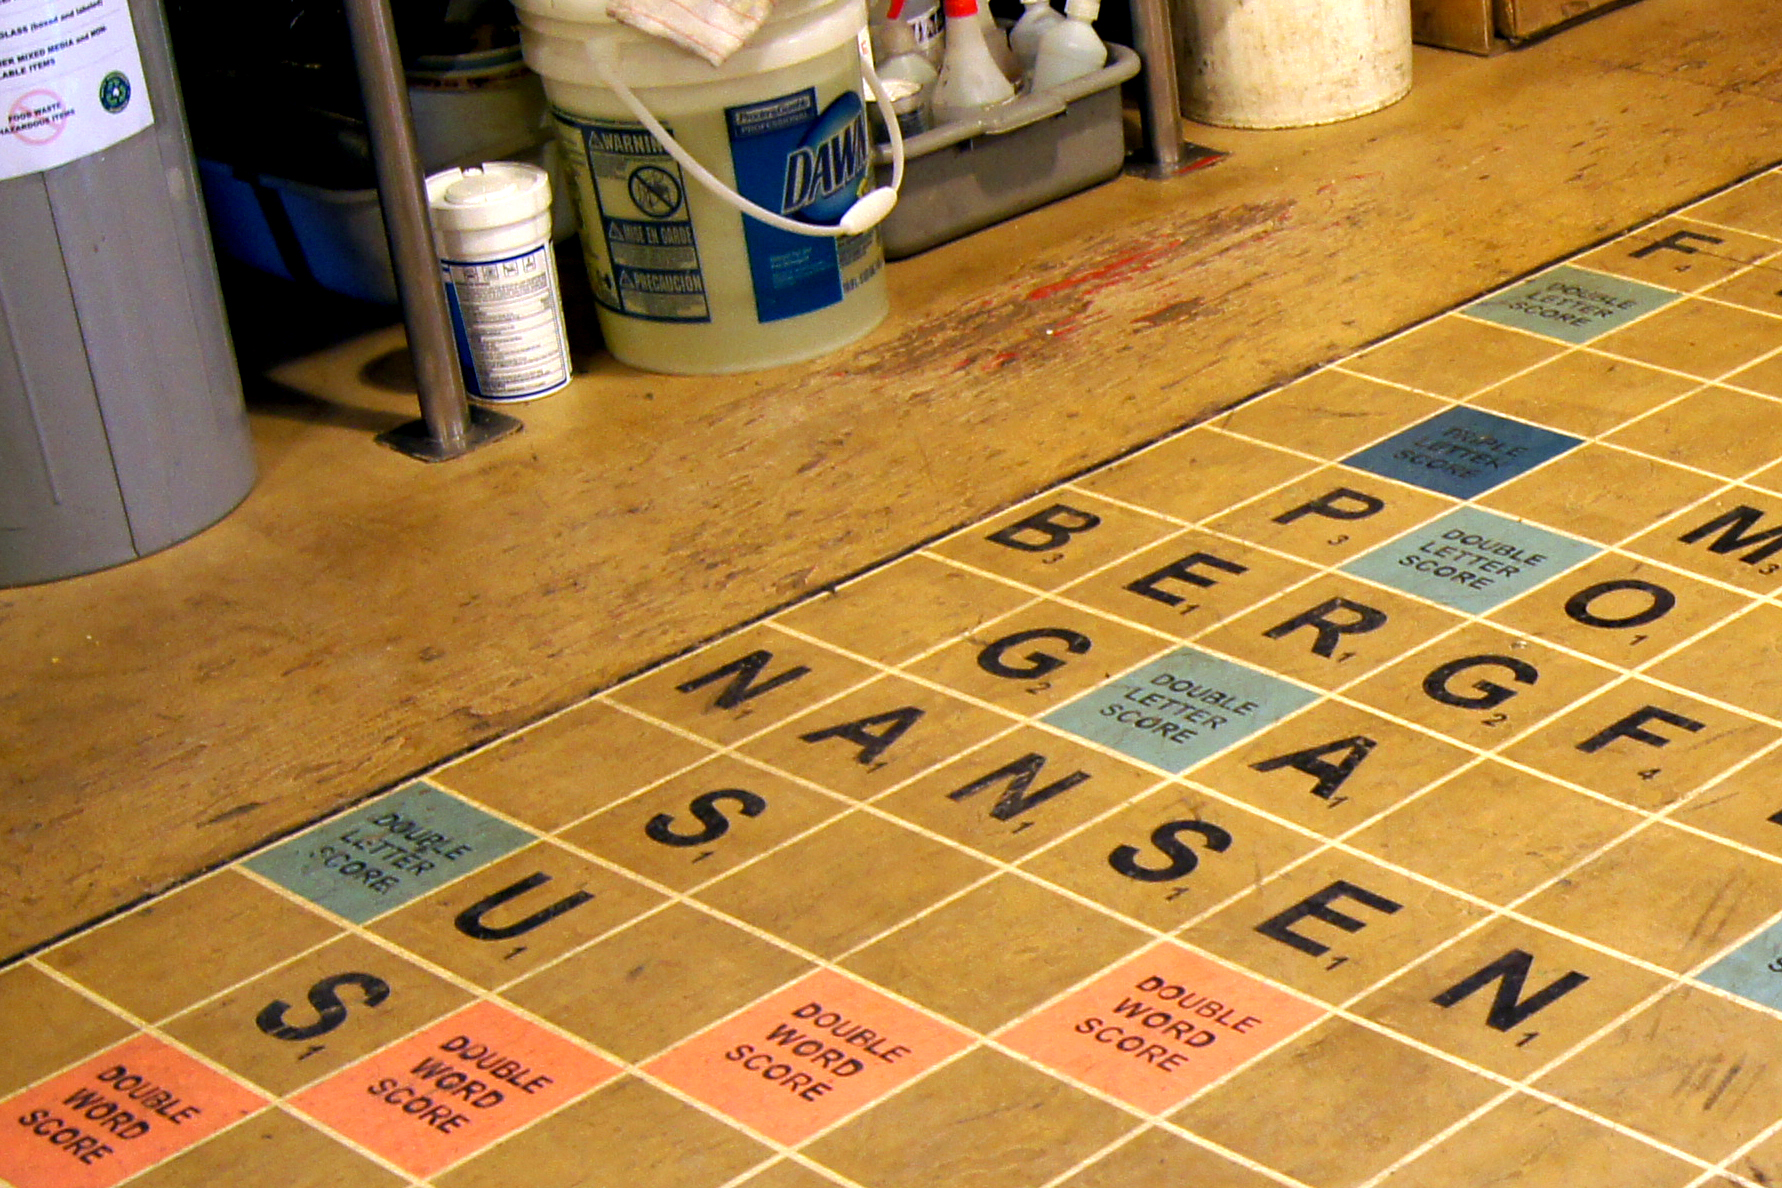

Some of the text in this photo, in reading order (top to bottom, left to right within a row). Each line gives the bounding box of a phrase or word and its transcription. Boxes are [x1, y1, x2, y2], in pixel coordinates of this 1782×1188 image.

[17, 49, 46, 64] MIXED
[47, 39, 74, 53] MEDIA
[29, 58, 56, 73] ITEMS
[8, 102, 62, 124] FOOD WASTE
[51, 108, 76, 123] ITEMS
[601, 131, 668, 154] WARNIN
[781, 110, 867, 215] DAWN
[1397, 554, 1496, 591] SCORE
[1418, 540, 1522, 579] LETTER
[1440, 528, 1548, 568] DOUBLE
[1123, 686, 1229, 731] LETTER
[1149, 672, 1260, 717] DOUBLE
[1098, 703, 1200, 745] SCORE
[1111, 997, 1218, 1049] WORD
[1135, 974, 1262, 1034] DOUBLE
[765, 1023, 866, 1078] WORD
[790, 1001, 912, 1063] DOUBLE
[1073, 1017, 1189, 1073] SCORE
[409, 1056, 506, 1109] WORD
[438, 1035, 553, 1095] DOUBLE
[723, 1044, 833, 1103] SCORE
[62, 1087, 152, 1141] WORD
[95, 1064, 202, 1126] DOUBLE
[366, 1077, 470, 1134] SCORE
[17, 1108, 115, 1166] SCORE
